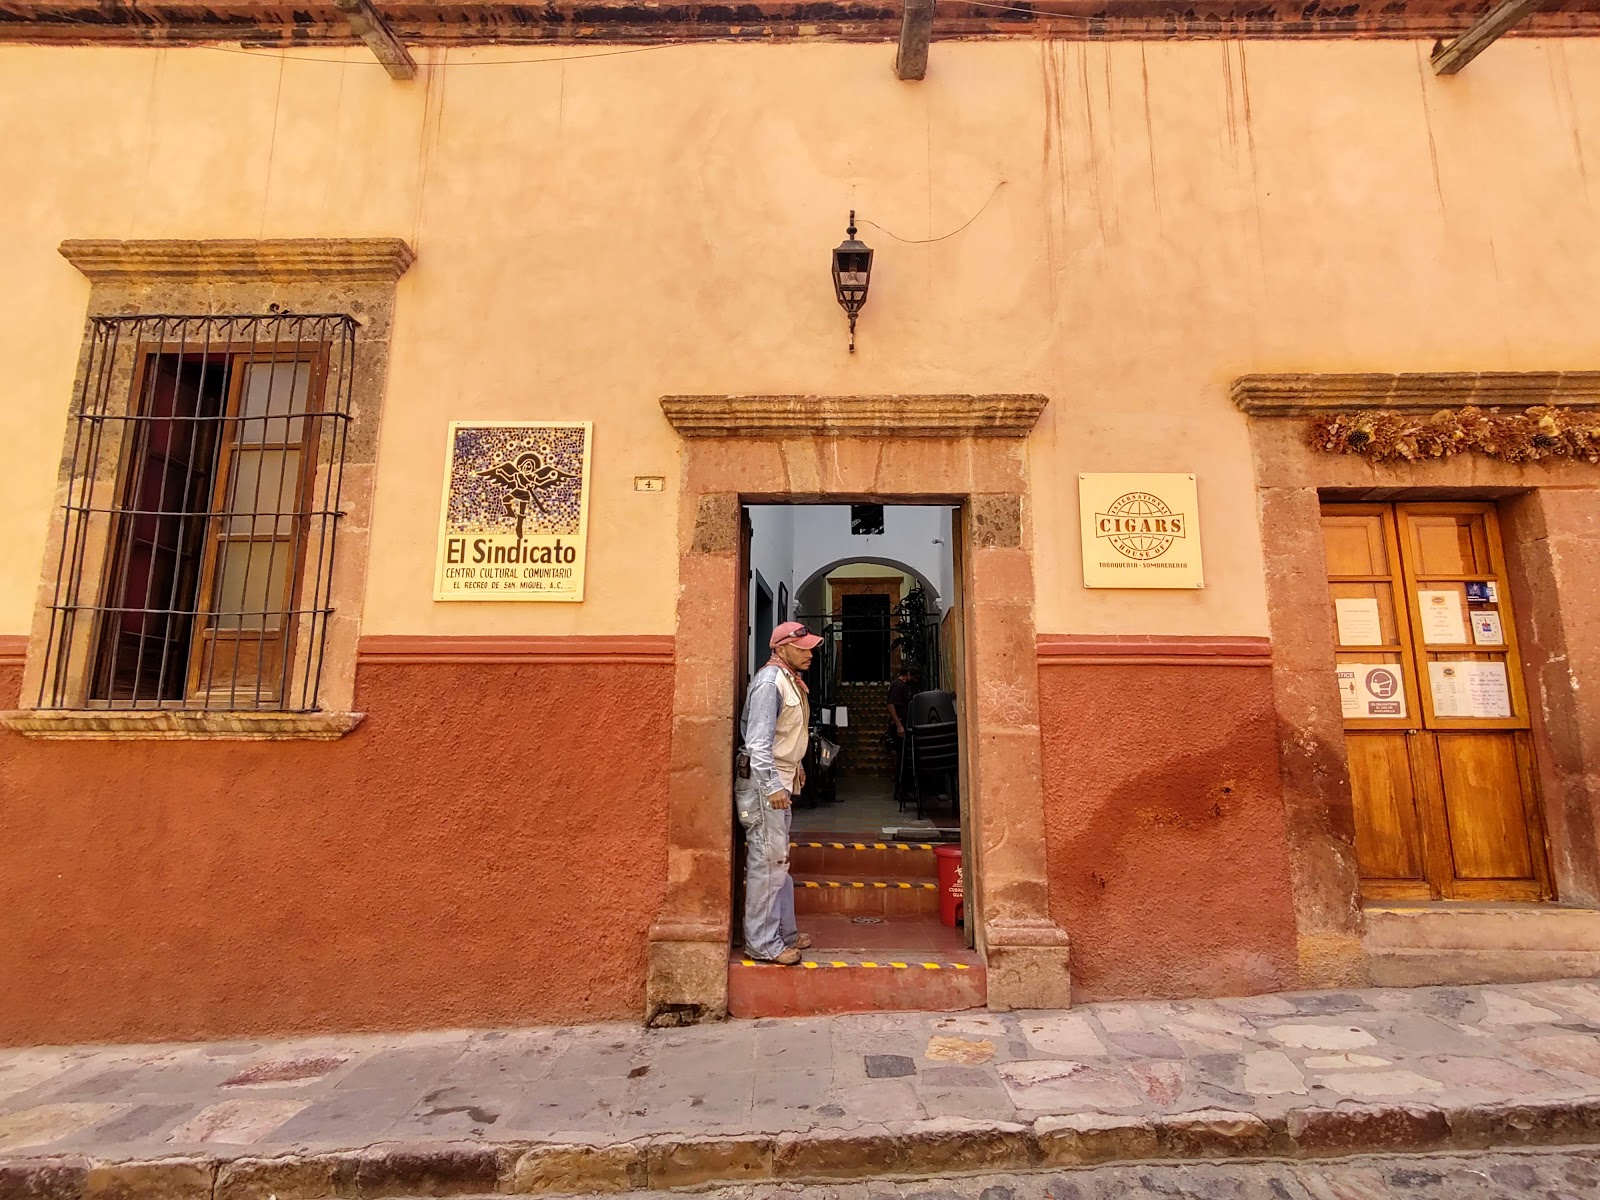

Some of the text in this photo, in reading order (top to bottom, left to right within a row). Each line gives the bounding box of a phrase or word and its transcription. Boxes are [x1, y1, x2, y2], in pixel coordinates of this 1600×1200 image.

[1111, 494, 1169, 514] INTERNATIONAL
[1099, 518, 1181, 533] CIGARS
[446, 538, 577, 564] El Sindicato
[1118, 544, 1165, 558] HOUSE OF
[445, 567, 573, 579] CENTRO CULTURAL COMUNITARIO
[453, 581, 461, 589] EL
[464, 581, 488, 589] RECREO
[491, 581, 500, 589] DE
[503, 581, 516, 589] SAN
